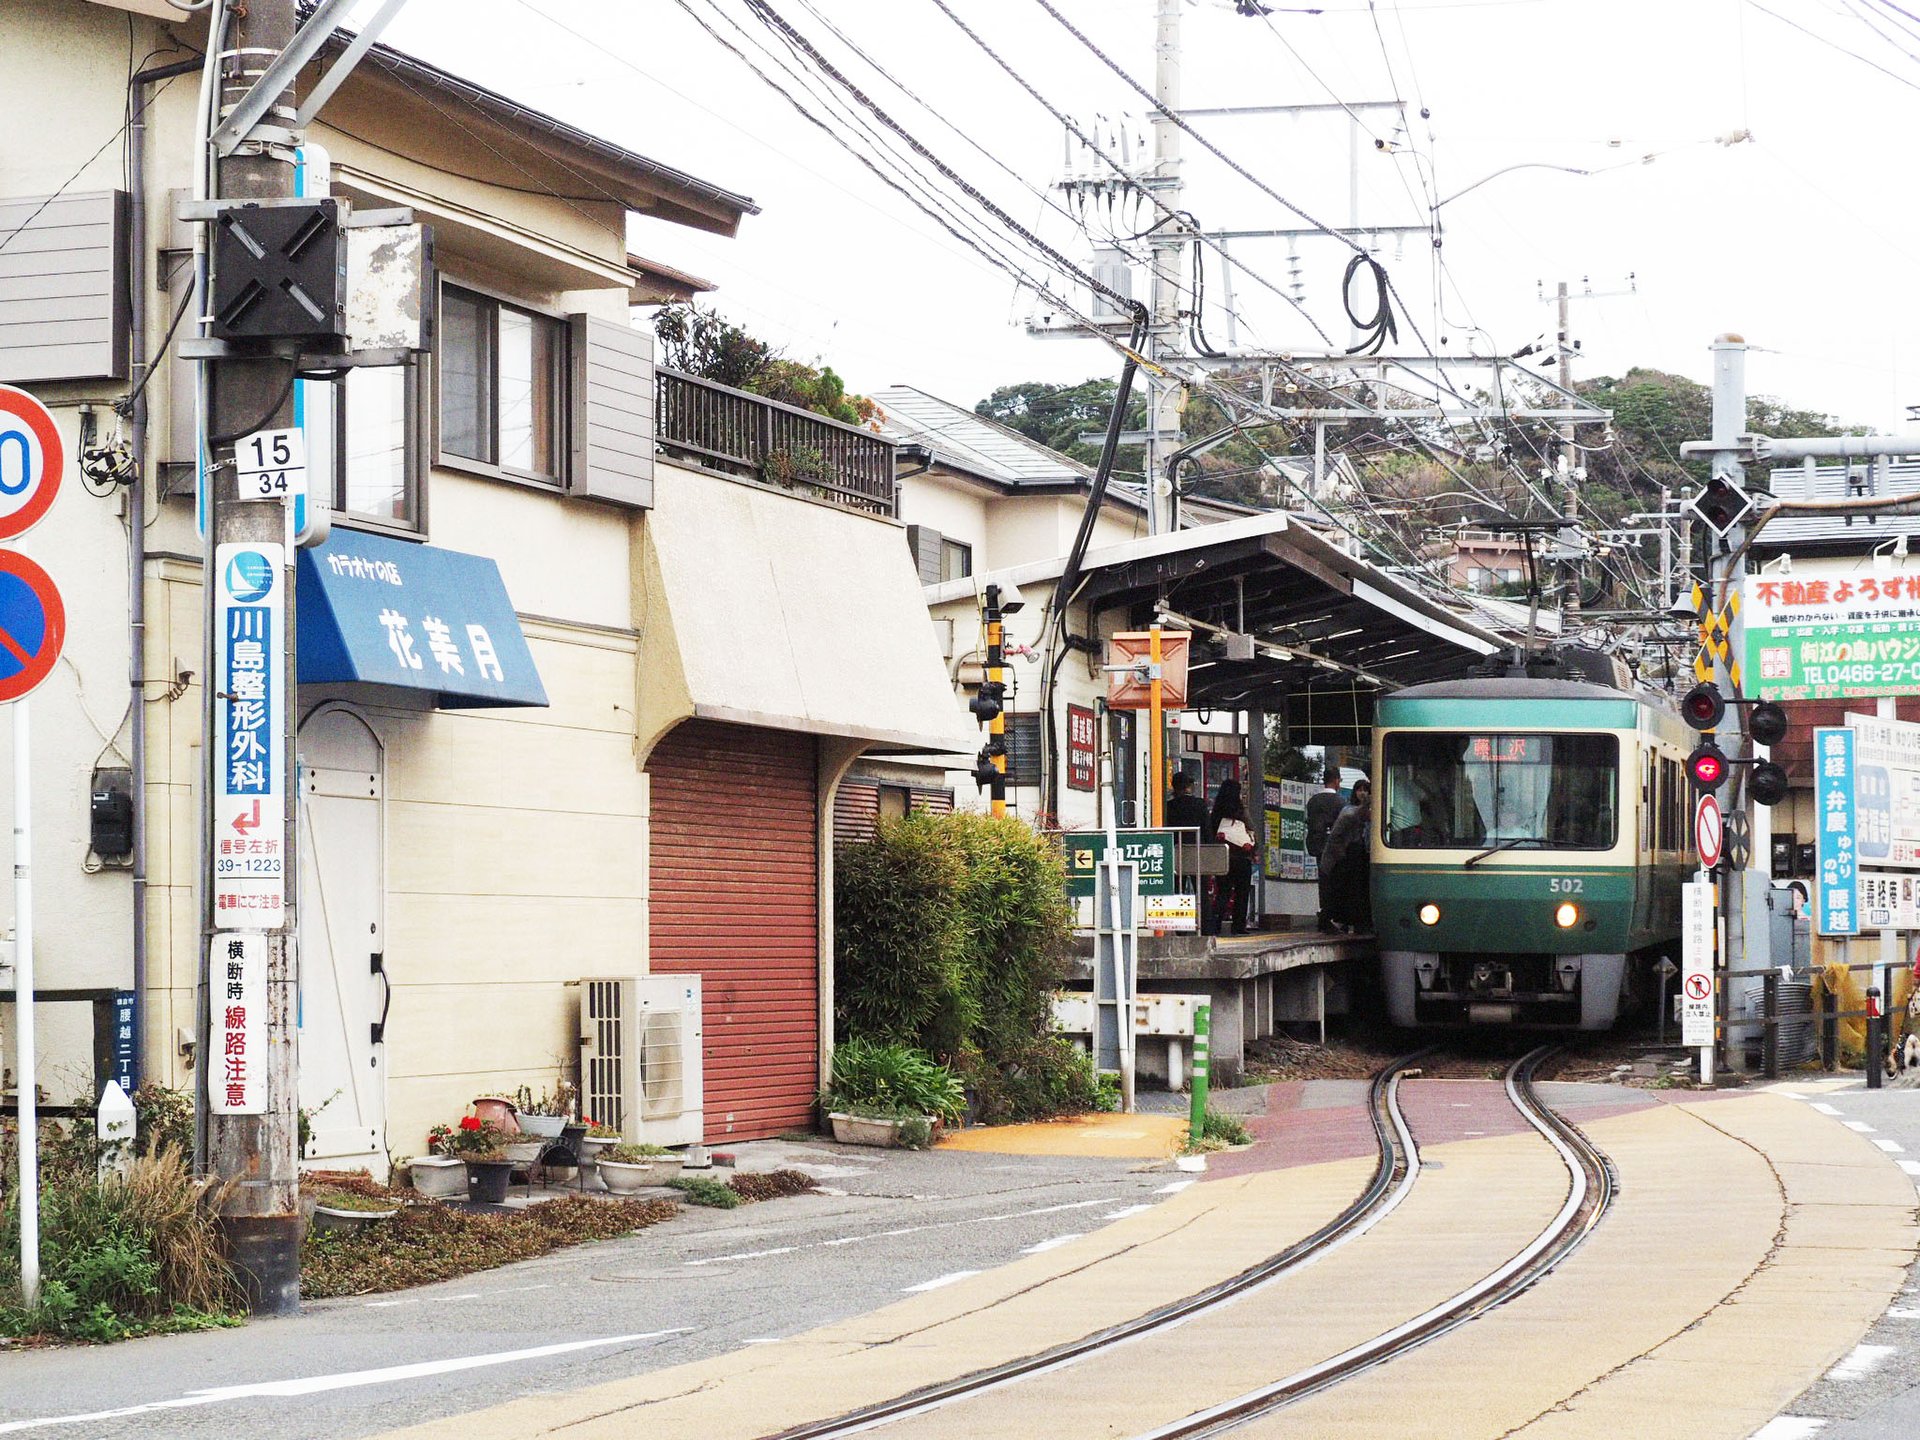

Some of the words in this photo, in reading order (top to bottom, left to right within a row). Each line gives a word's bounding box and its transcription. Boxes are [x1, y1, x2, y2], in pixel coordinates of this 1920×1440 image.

[251, 434, 291, 467] 15
[259, 471, 288, 494] 34
[327, 552, 403, 586] カラオケの店
[378, 608, 504, 683] 花美月
[1802, 667, 1826, 684] TEL
[231, 609, 267, 792] 川島整形外科
[220, 839, 279, 855] 信号左折
[1837, 835, 1852, 879] ゆかり
[217, 859, 282, 872] 39-1223
[1139, 859, 1164, 873] りば
[1149, 878, 1164, 886] Line
[1549, 878, 1583, 894] 502
[218, 893, 281, 910] 電車にご注意
[1828, 889, 1850, 931] 腰越
[225, 940, 247, 1107] 横断時線路注意
[119, 1008, 132, 1090] 腰越二丁目
